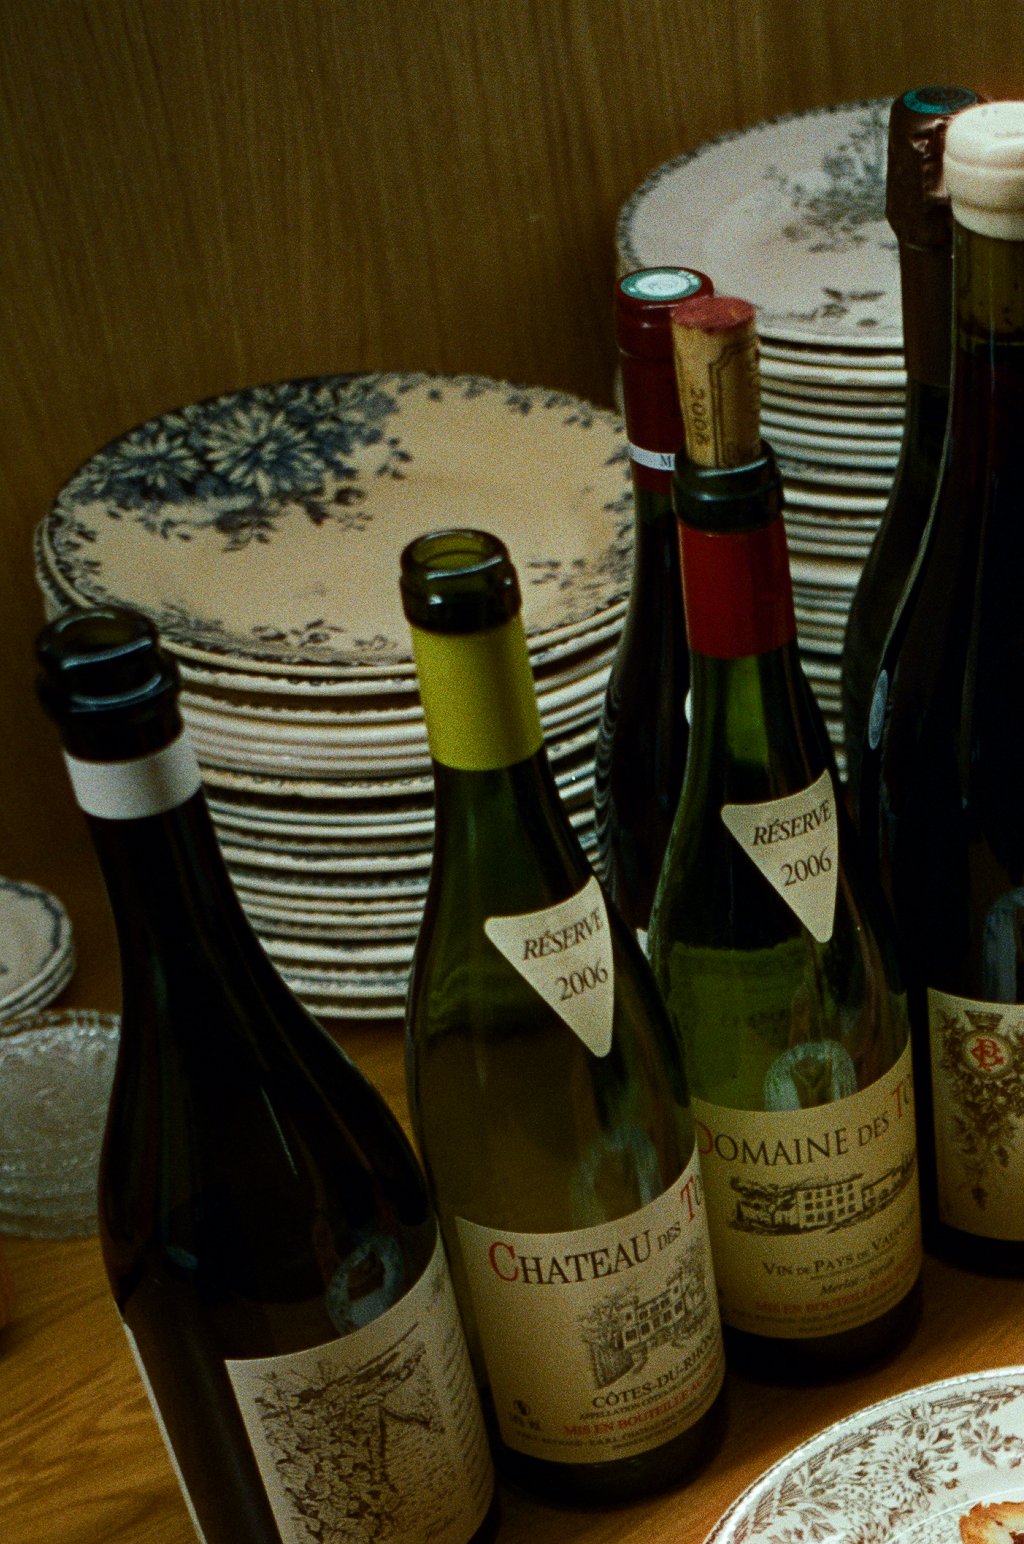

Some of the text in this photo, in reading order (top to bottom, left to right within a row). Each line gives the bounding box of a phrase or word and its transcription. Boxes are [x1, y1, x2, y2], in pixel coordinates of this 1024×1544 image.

[752, 801, 832, 846] RÉSERVE
[780, 847, 832, 887] 2006
[523, 907, 604, 961] RÉSERVE
[554, 959, 609, 1001] 2006
[858, 1110, 890, 1147] DES
[488, 1231, 652, 1285] CHATEAU
[656, 1221, 682, 1251] DES
